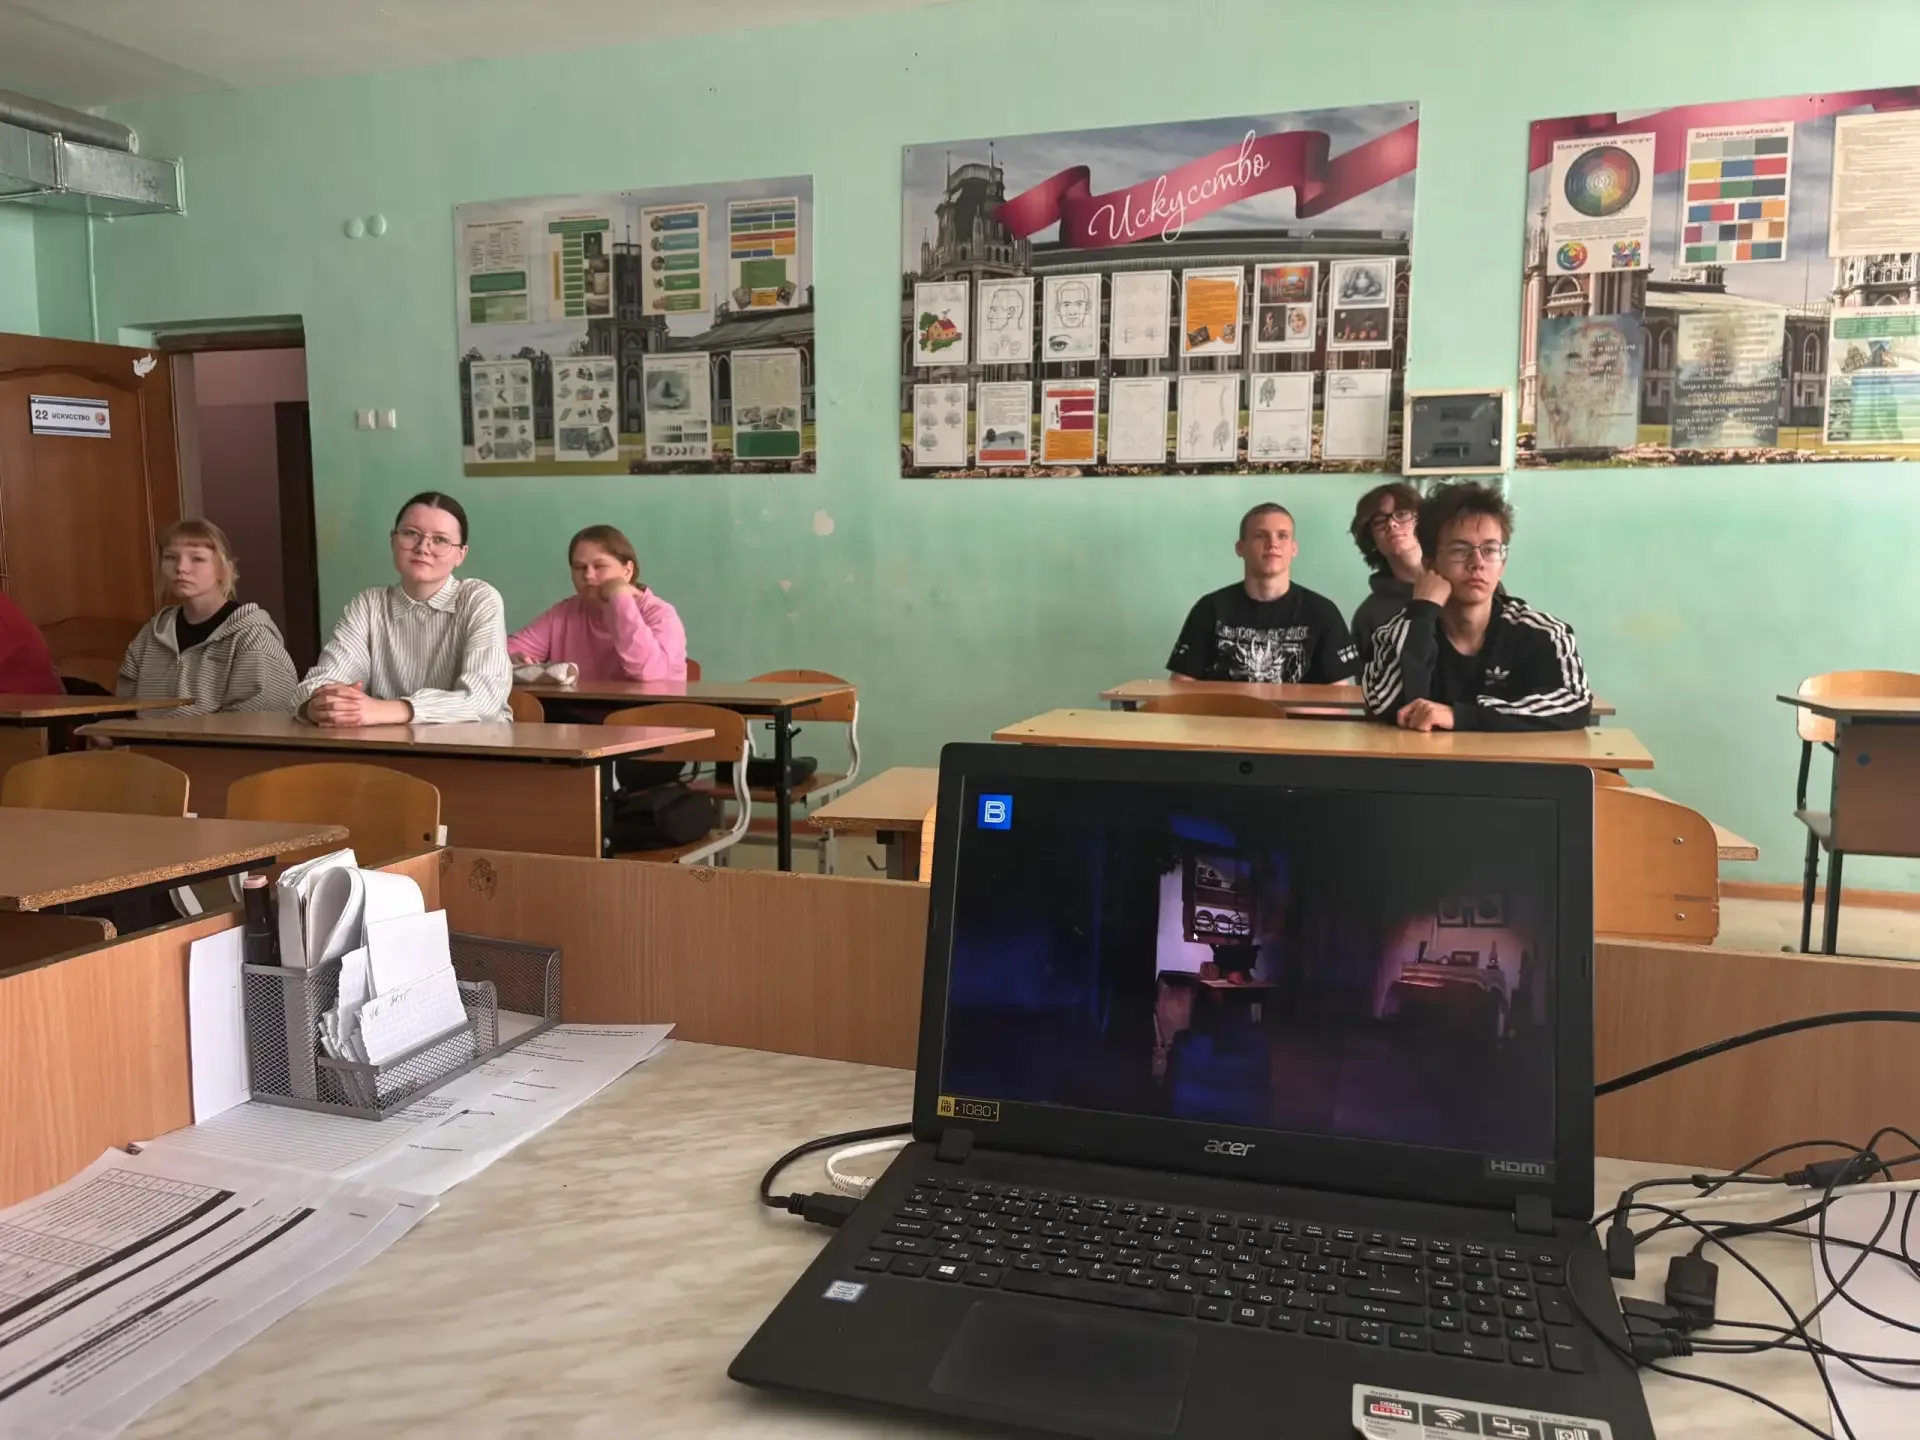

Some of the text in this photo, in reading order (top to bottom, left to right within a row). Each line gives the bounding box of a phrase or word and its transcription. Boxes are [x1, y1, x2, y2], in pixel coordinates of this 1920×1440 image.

[1088, 129, 1271, 243] Искусство
[35, 409, 90, 421] 22 ИСКУССТВО
[940, 1104, 952, 1113] HD
[961, 1103, 992, 1117] 1080
[1204, 1139, 1256, 1157] acer
